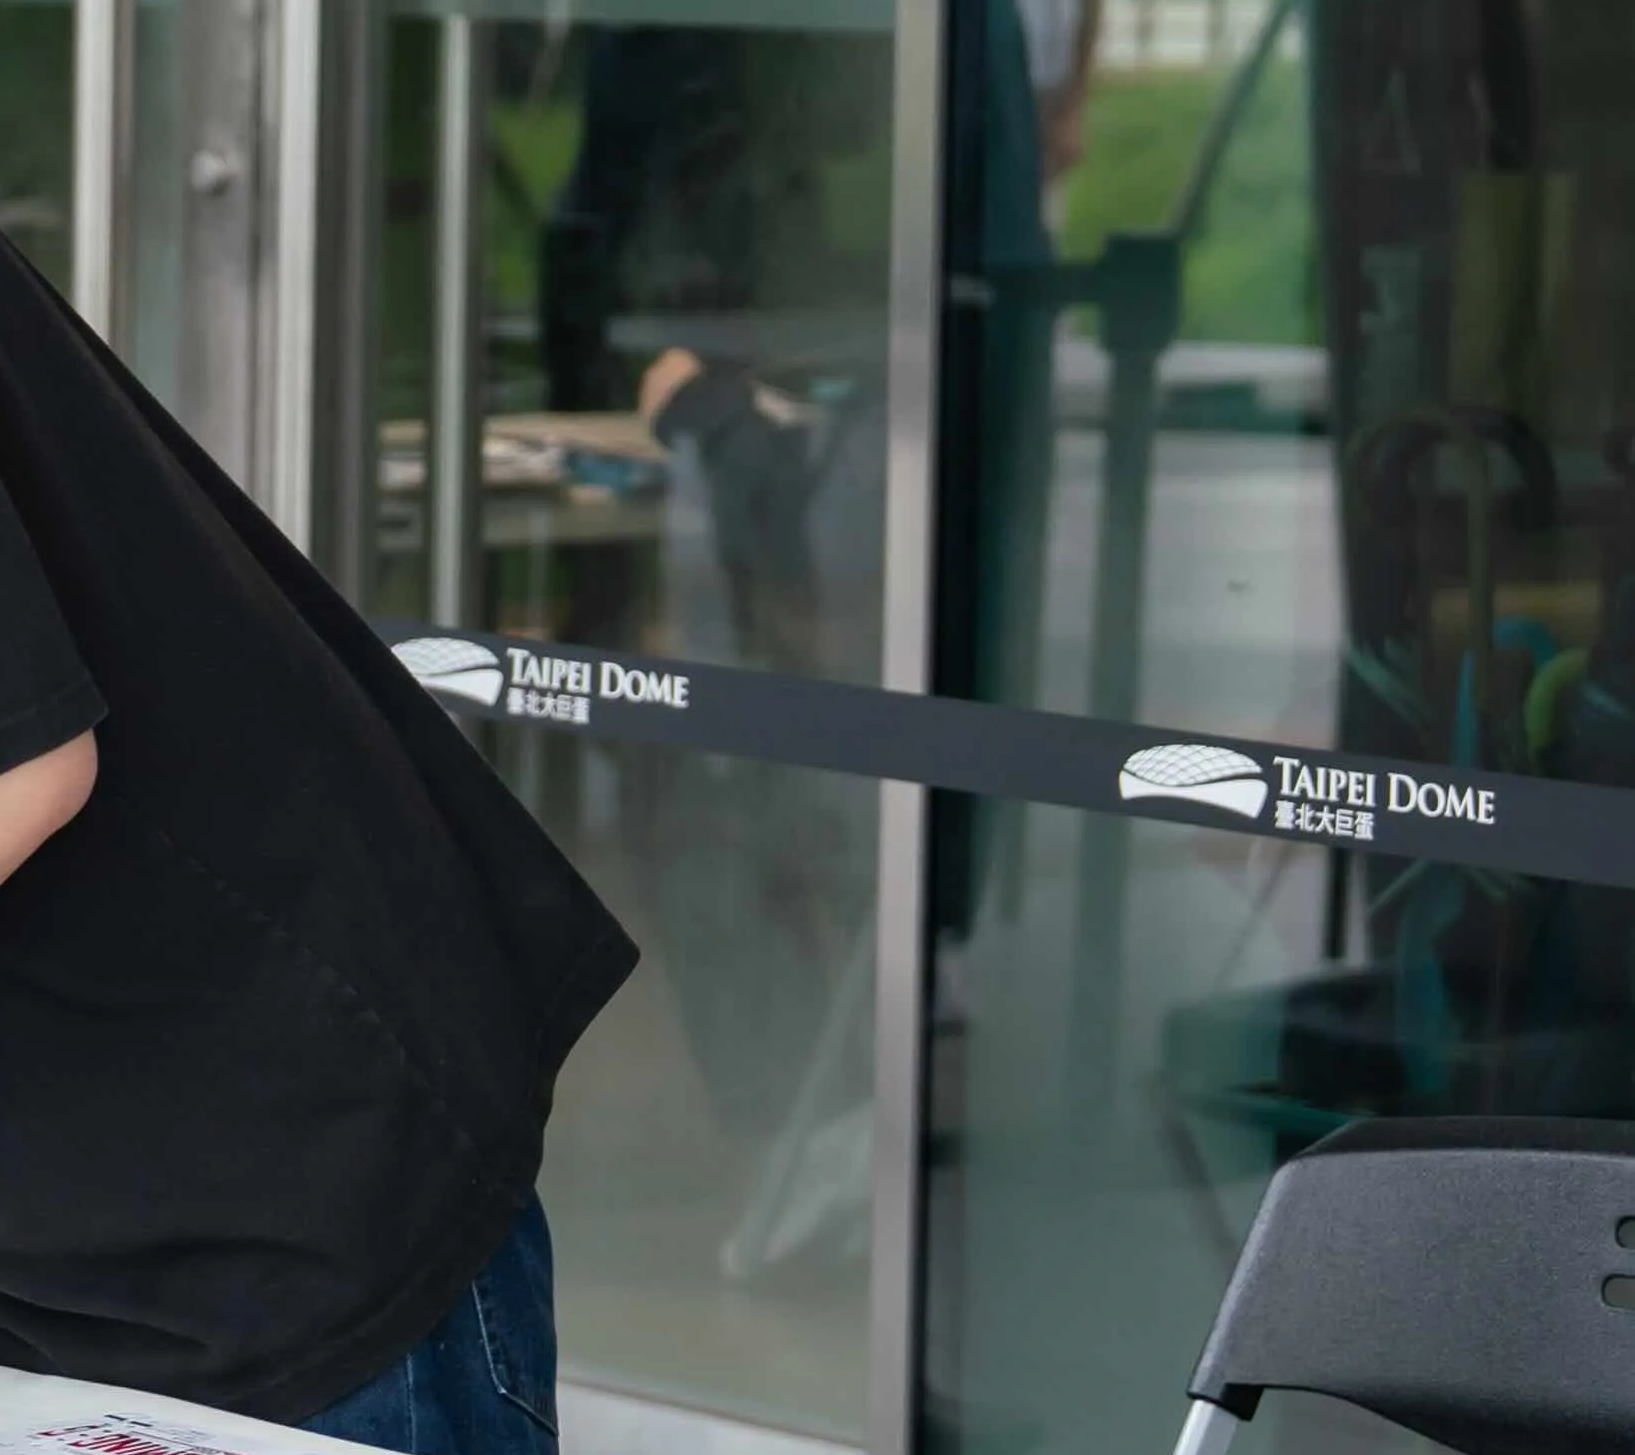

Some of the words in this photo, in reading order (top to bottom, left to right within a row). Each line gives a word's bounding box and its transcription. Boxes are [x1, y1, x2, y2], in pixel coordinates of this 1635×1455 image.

[507, 647, 593, 695] TAIPEI
[600, 661, 690, 709] DOME
[1273, 756, 1377, 808] TAIPEI
[1387, 772, 1496, 825] DOME
[1274, 800, 1375, 841] 臺北大巨蛋
